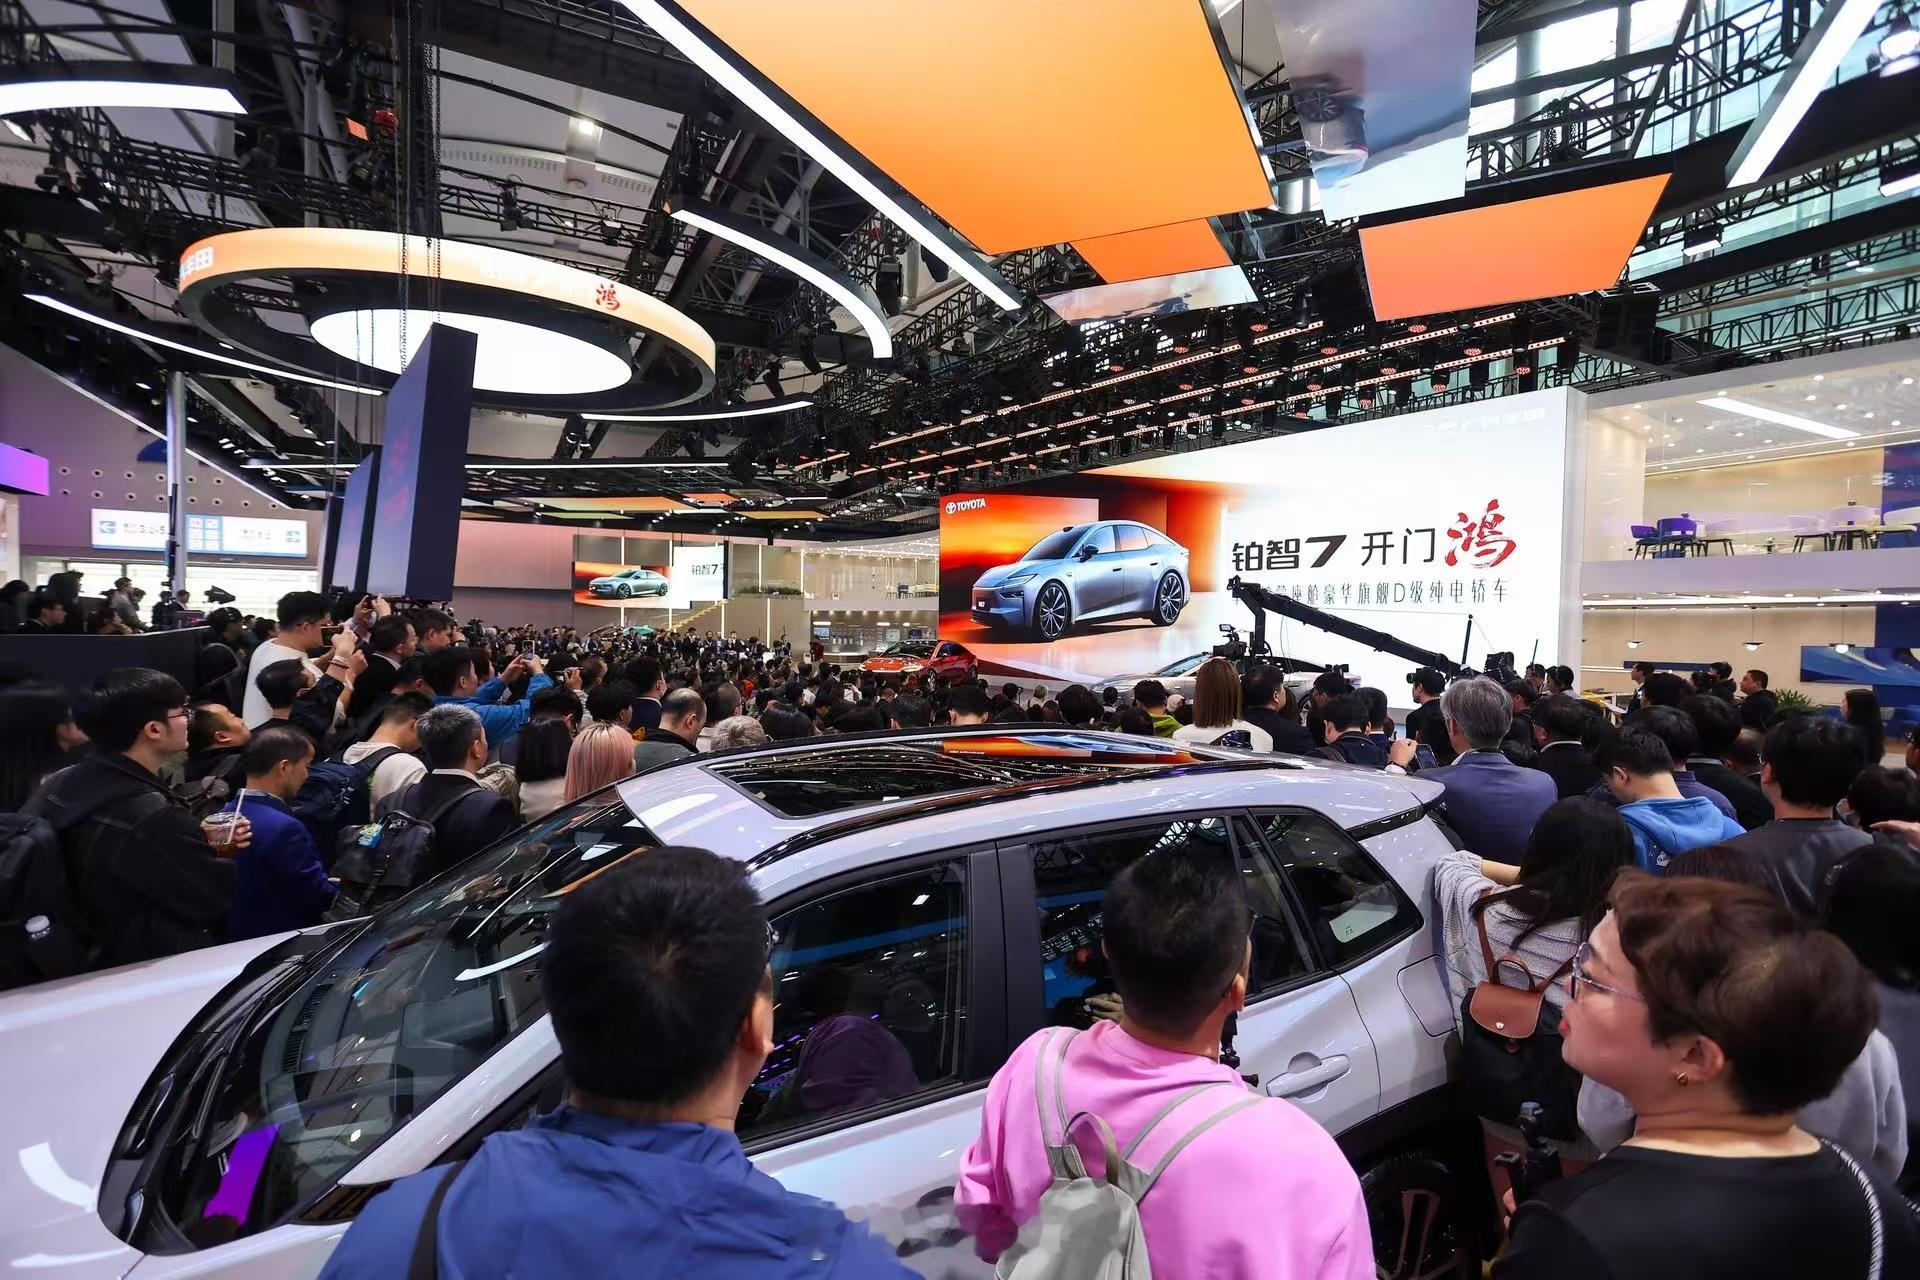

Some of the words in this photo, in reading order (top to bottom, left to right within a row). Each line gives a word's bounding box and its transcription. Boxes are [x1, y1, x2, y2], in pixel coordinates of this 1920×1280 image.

[595, 283, 621, 312] 鸿
[956, 498, 987, 512] TOYOTA
[1231, 534, 1348, 572] 铂智7
